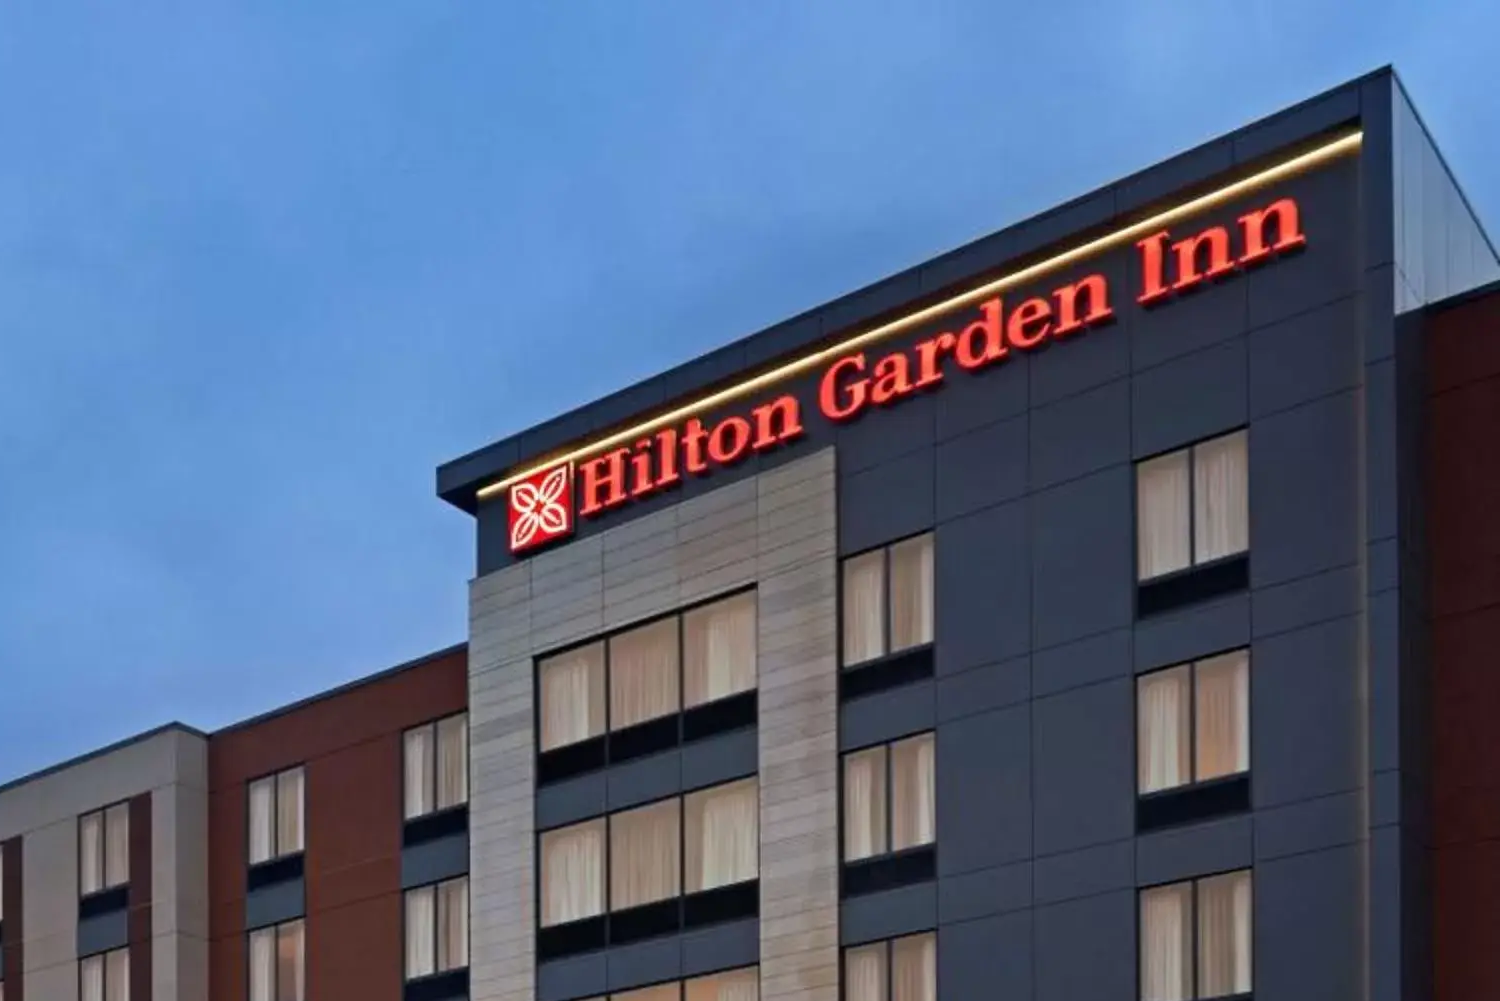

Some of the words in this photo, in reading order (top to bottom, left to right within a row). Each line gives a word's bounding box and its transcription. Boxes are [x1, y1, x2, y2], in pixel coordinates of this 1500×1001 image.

[579, 393, 804, 517] Hilton
[818, 273, 1114, 421] Garden
[1135, 198, 1307, 304] Inn
